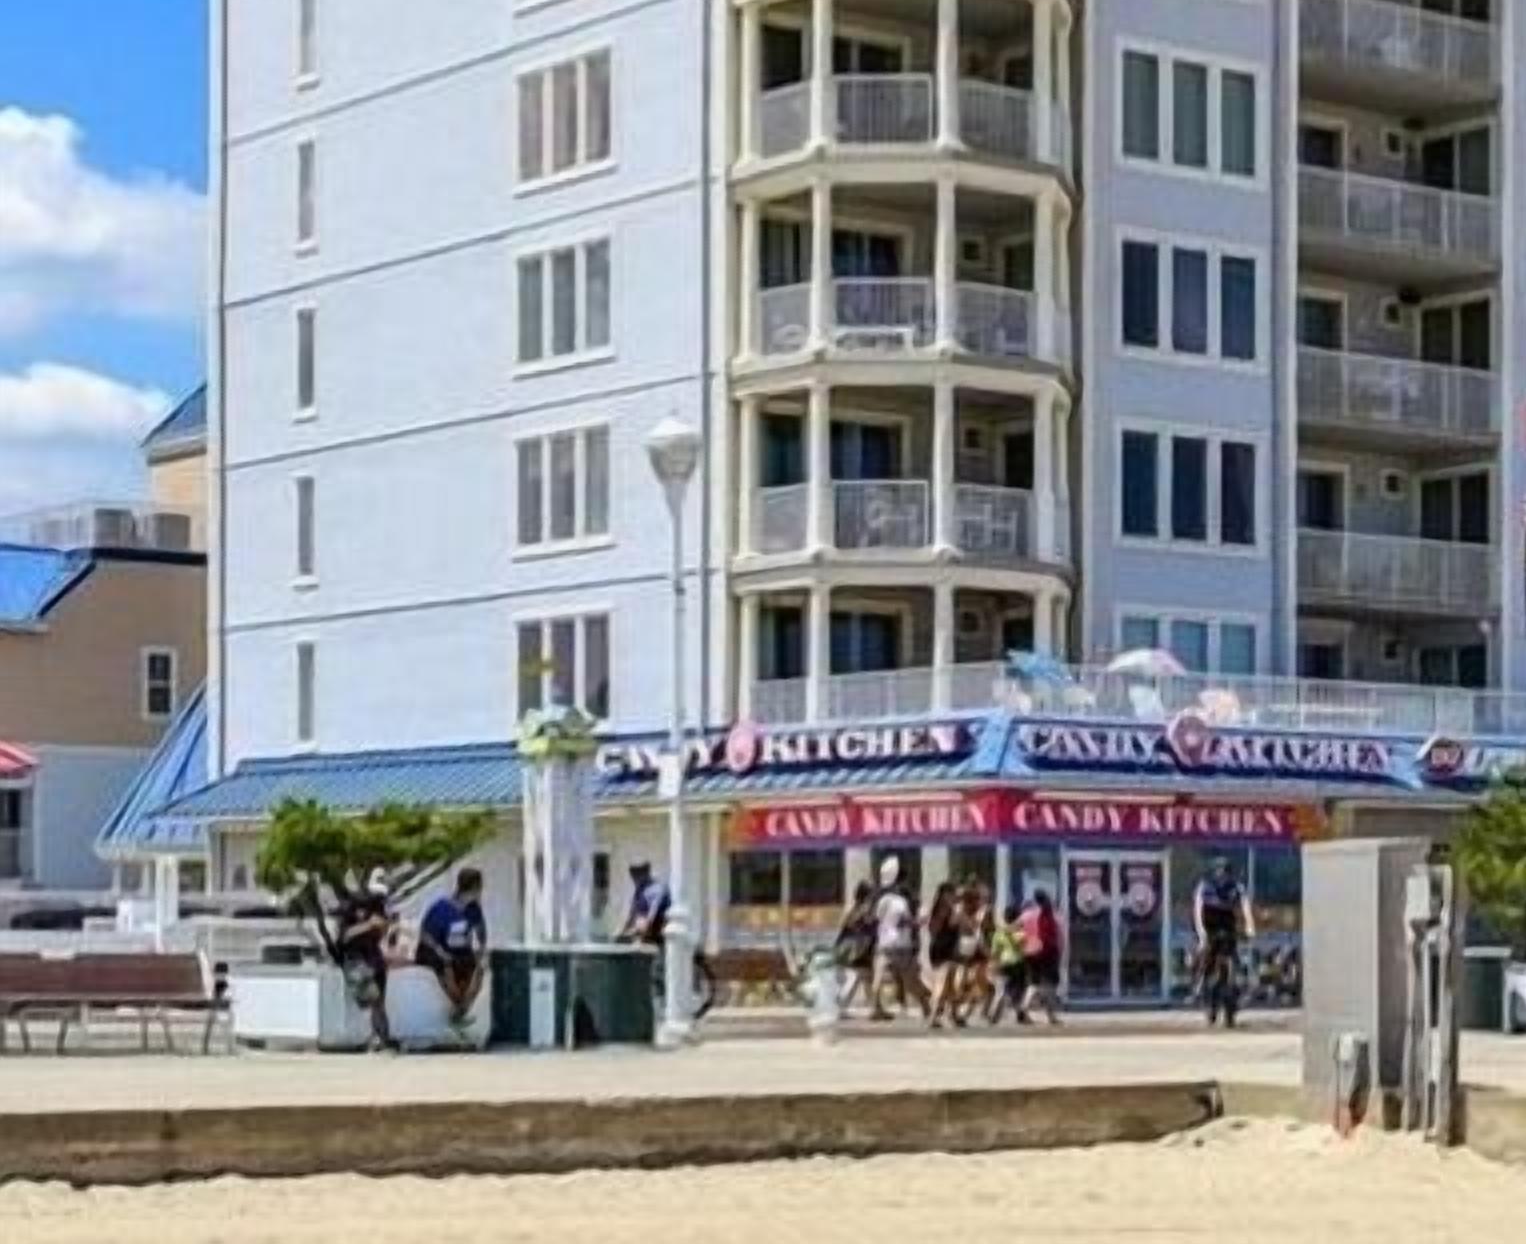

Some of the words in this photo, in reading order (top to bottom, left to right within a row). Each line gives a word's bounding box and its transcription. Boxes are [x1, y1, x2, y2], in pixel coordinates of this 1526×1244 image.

[762, 725, 957, 762] KITCHEN
[1021, 724, 1157, 763] CANDY
[765, 807, 852, 838] CANDY
[862, 802, 985, 835] KITCHEN
[1014, 802, 1123, 832] CANDY
[1140, 806, 1283, 834] KITCHEN
